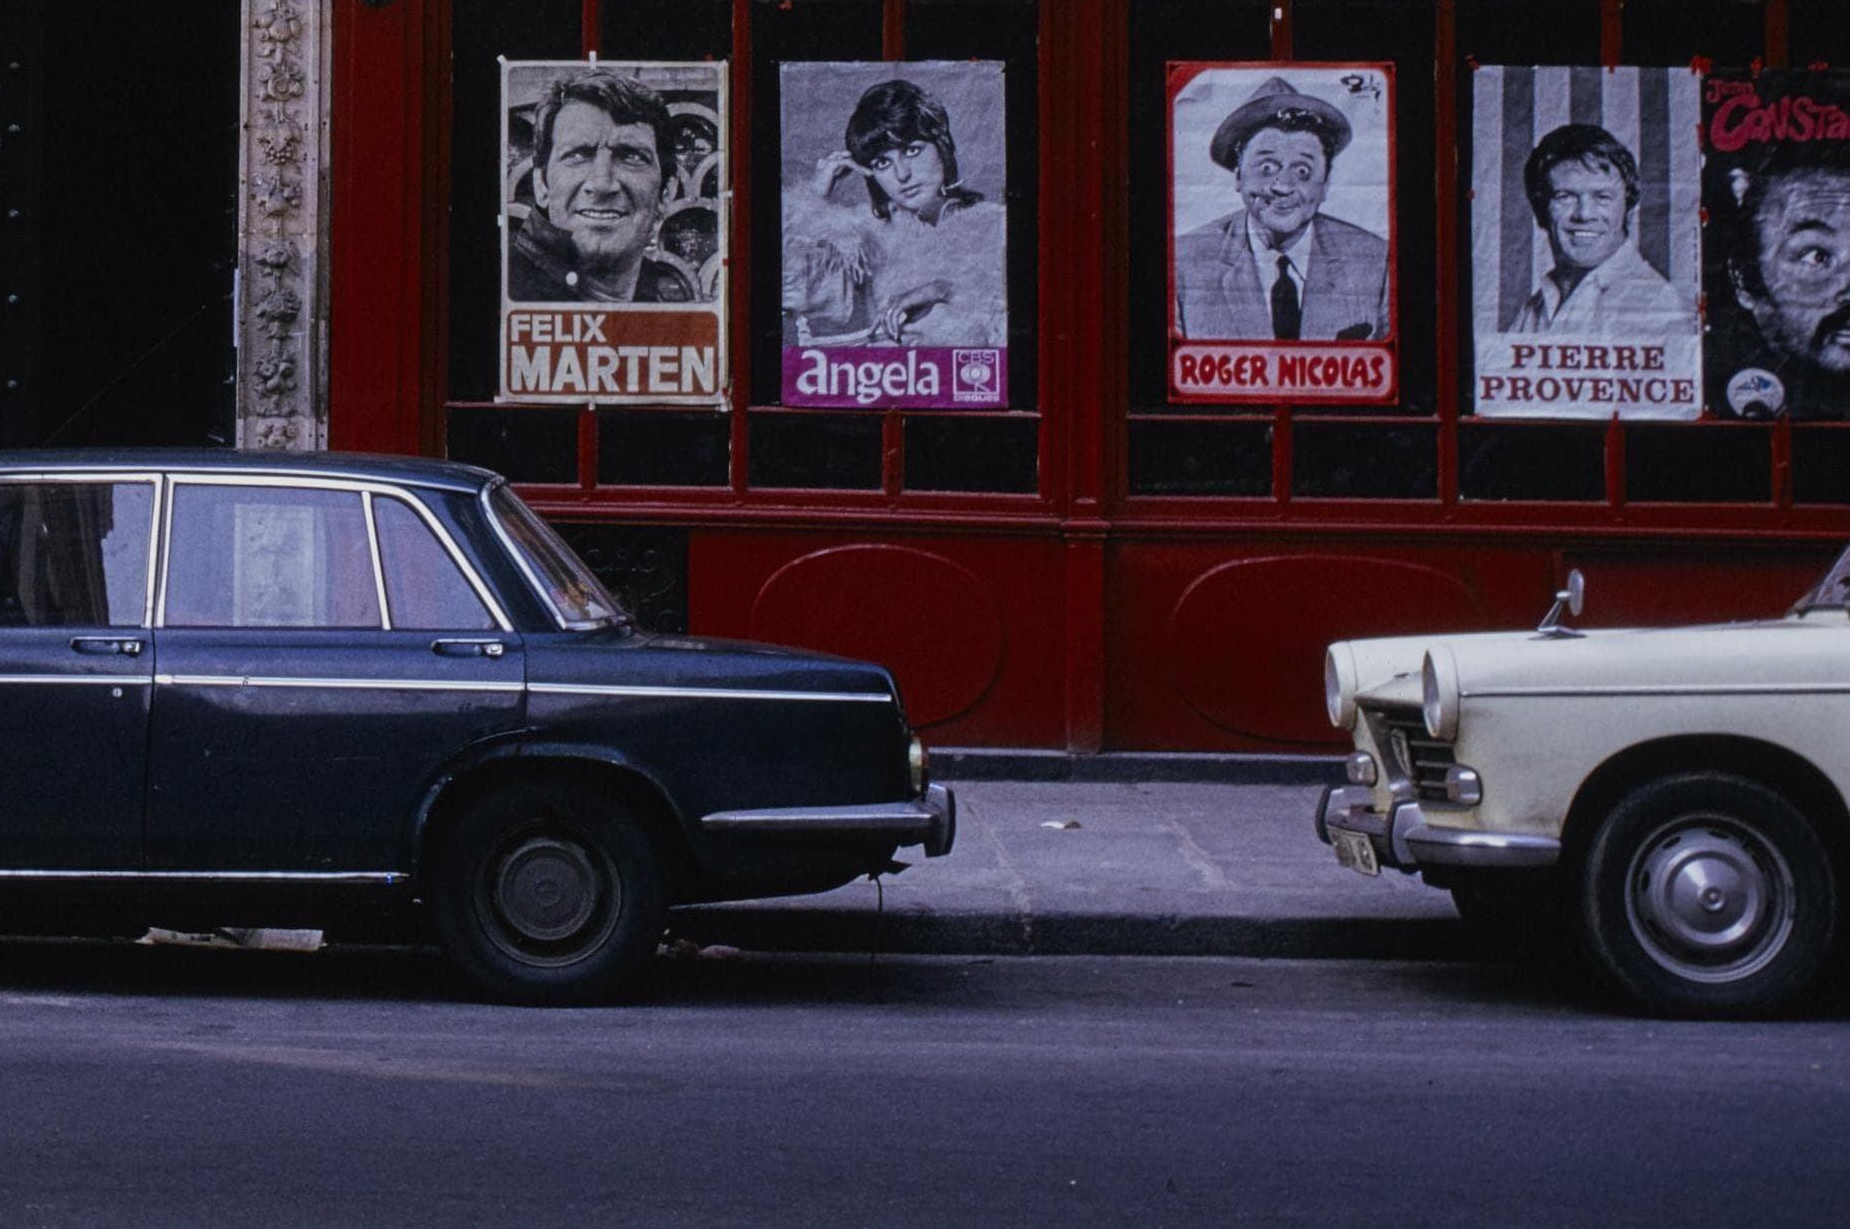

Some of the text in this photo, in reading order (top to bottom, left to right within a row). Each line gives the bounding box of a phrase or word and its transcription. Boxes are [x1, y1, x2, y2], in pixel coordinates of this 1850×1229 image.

[510, 313, 606, 344] FELIX
[510, 346, 715, 394] MARTEN
[957, 351, 995, 364] CBS
[1179, 354, 1385, 387] ROGER NICOLAS
[1510, 344, 1665, 370] PIERRE
[1479, 377, 1695, 405] PROVENCE
